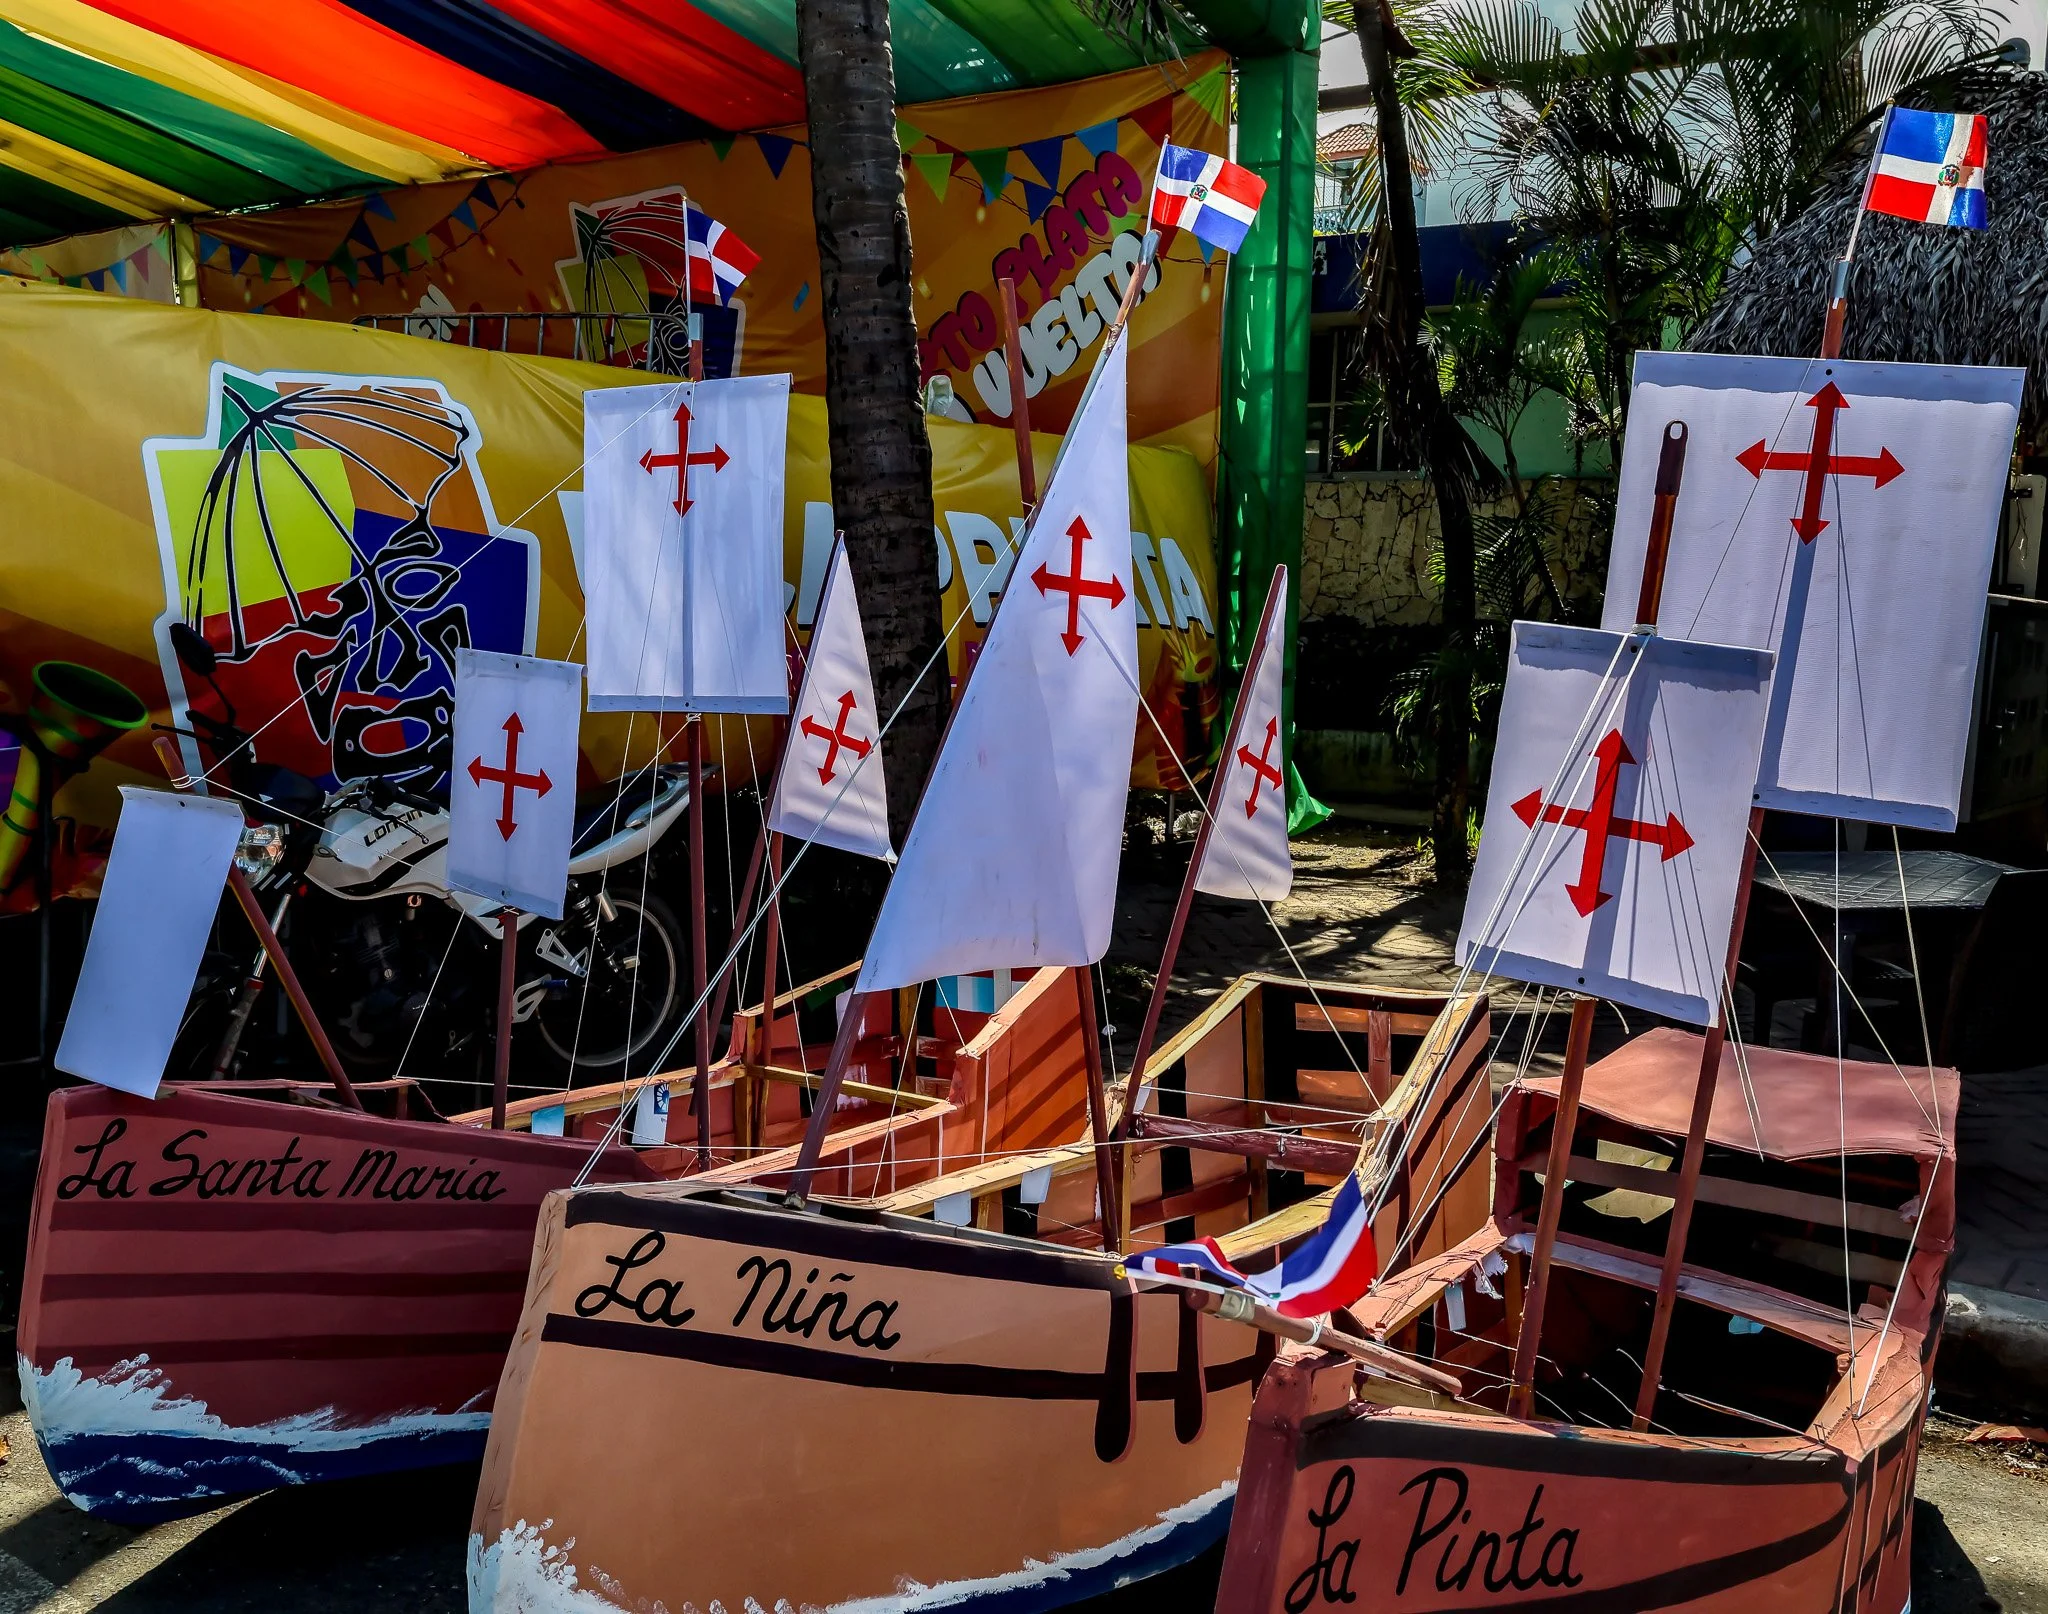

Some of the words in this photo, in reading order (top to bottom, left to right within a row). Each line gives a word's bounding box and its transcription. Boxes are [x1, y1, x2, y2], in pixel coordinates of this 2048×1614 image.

[992, 150, 1143, 318] PLATA
[57, 1118, 139, 1199] La
[149, 1129, 332, 1199] Santa
[575, 1229, 696, 1327] La
[732, 1255, 901, 1350] Niña
[1284, 1464, 1361, 1614] La
[1396, 1467, 1583, 1596] Pinta
